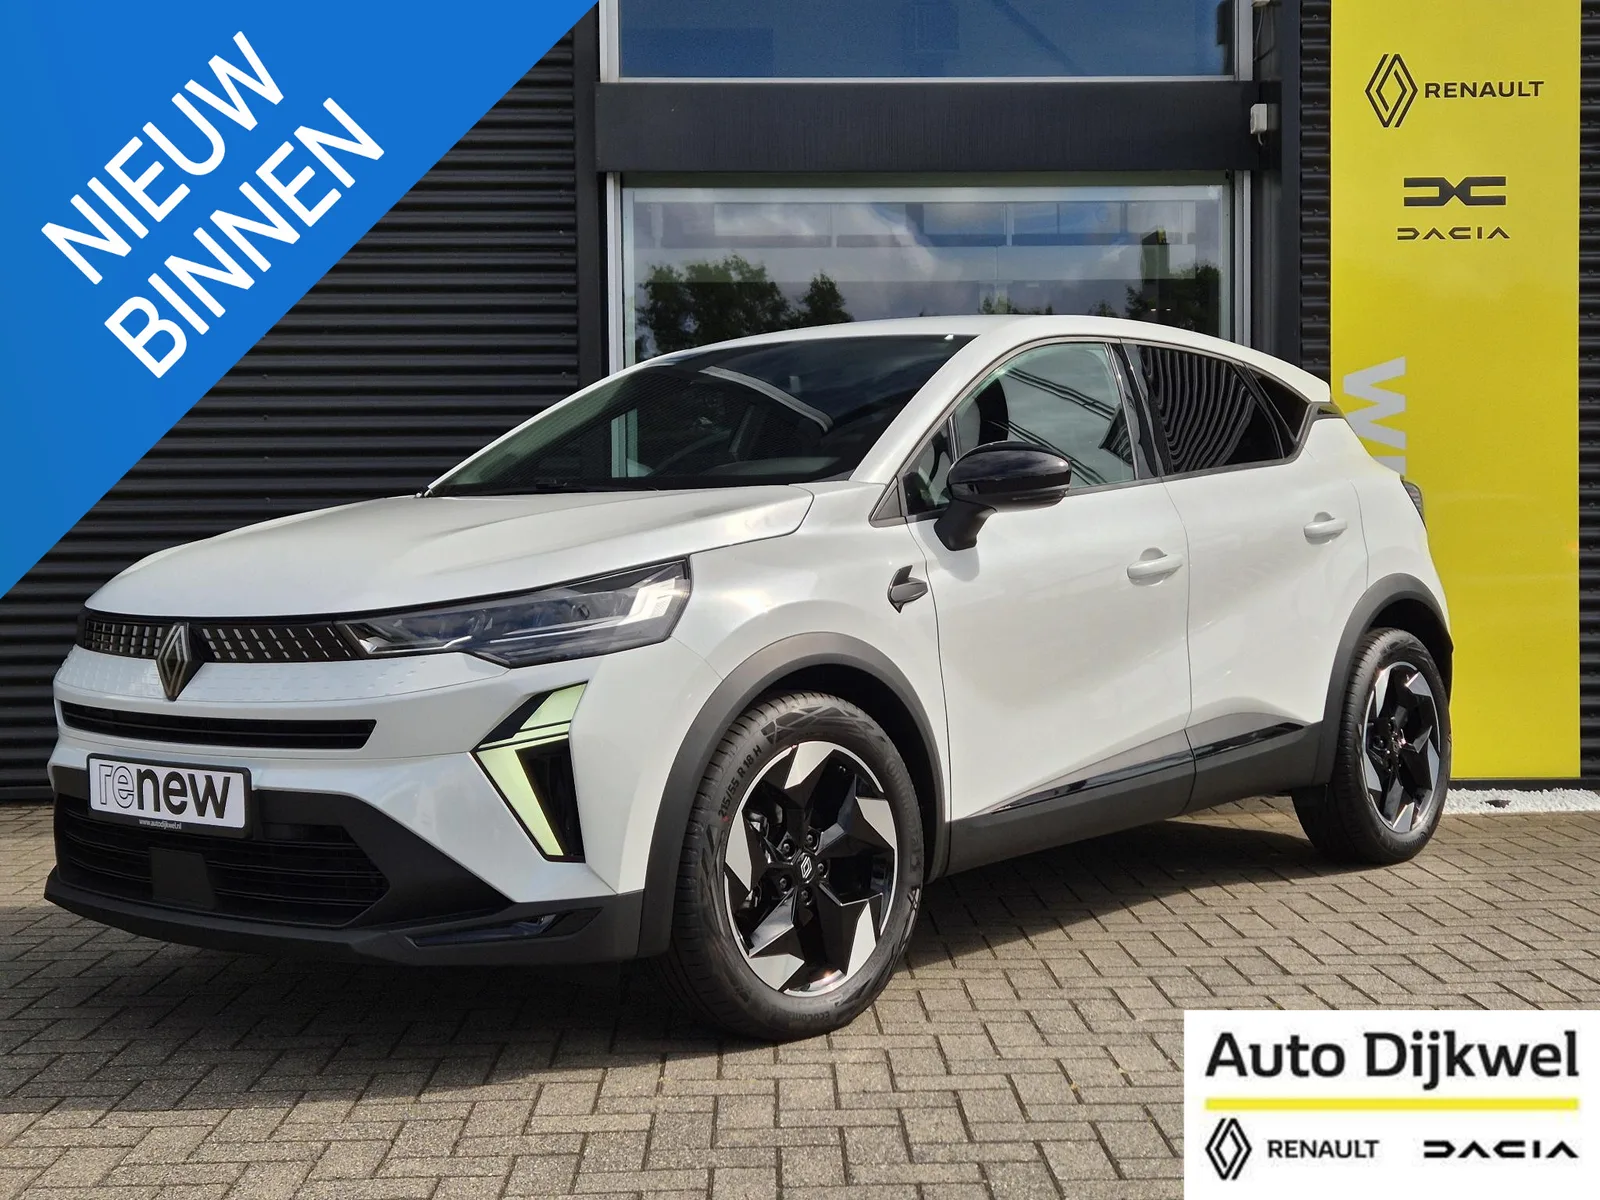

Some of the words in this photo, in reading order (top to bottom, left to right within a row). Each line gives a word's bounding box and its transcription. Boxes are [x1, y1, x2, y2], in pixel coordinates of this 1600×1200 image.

[1424, 80, 1545, 98] RENAULT
[1397, 227, 1510, 240] DACIA
[718, 777, 740, 817] 215/55
[737, 767, 746, 778] R
[743, 754, 754, 769] 18
[753, 744, 762, 756] H
[99, 764, 231, 819] renew
[139, 819, 182, 830] www.autodijkwel.nl
